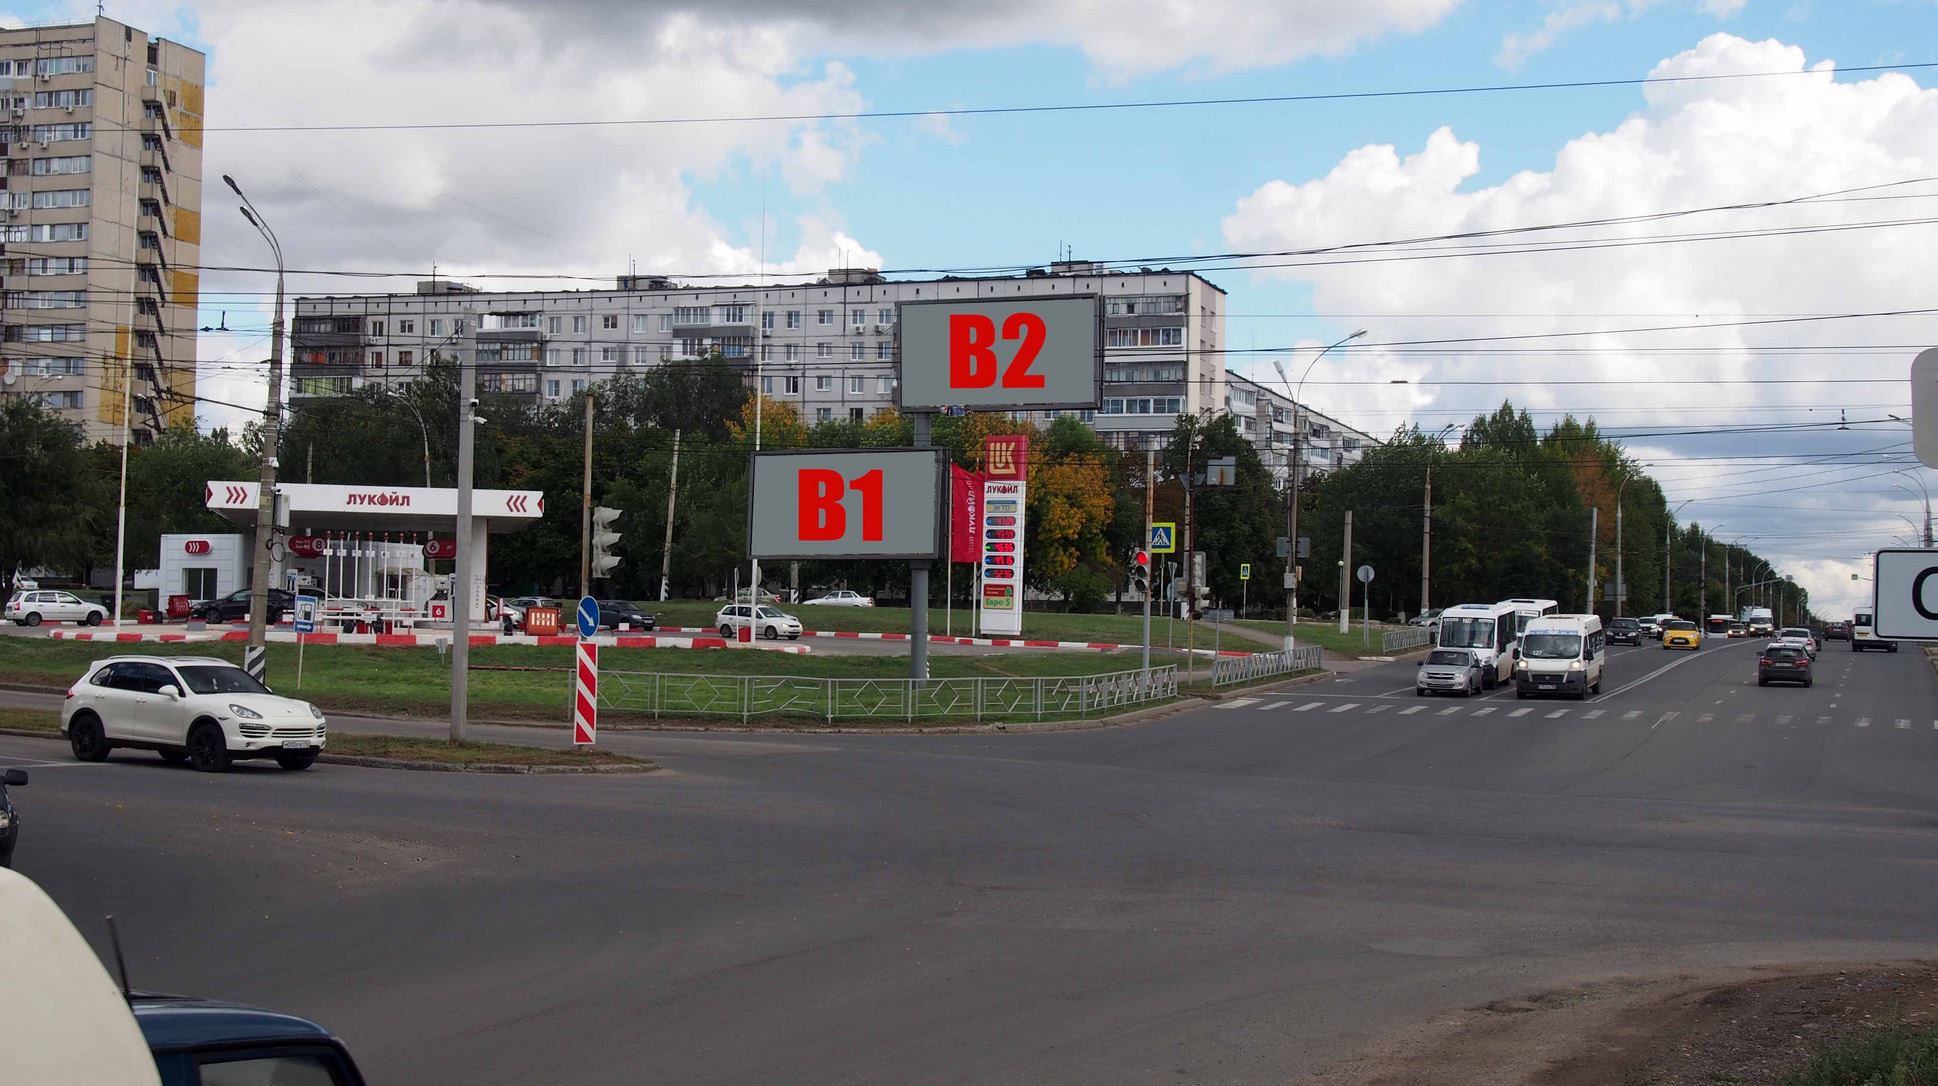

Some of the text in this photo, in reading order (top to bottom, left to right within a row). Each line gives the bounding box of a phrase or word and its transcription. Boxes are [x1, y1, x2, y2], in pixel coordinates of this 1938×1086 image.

[986, 484, 1018, 494] ЛУКОЙЛ
[346, 491, 411, 506] ЛУКОЙЛ
[966, 491, 976, 534] ЛУКОЙЛ
[316, 540, 322, 549] 8
[430, 542, 437, 552] 6
[435, 607, 442, 616] 6
